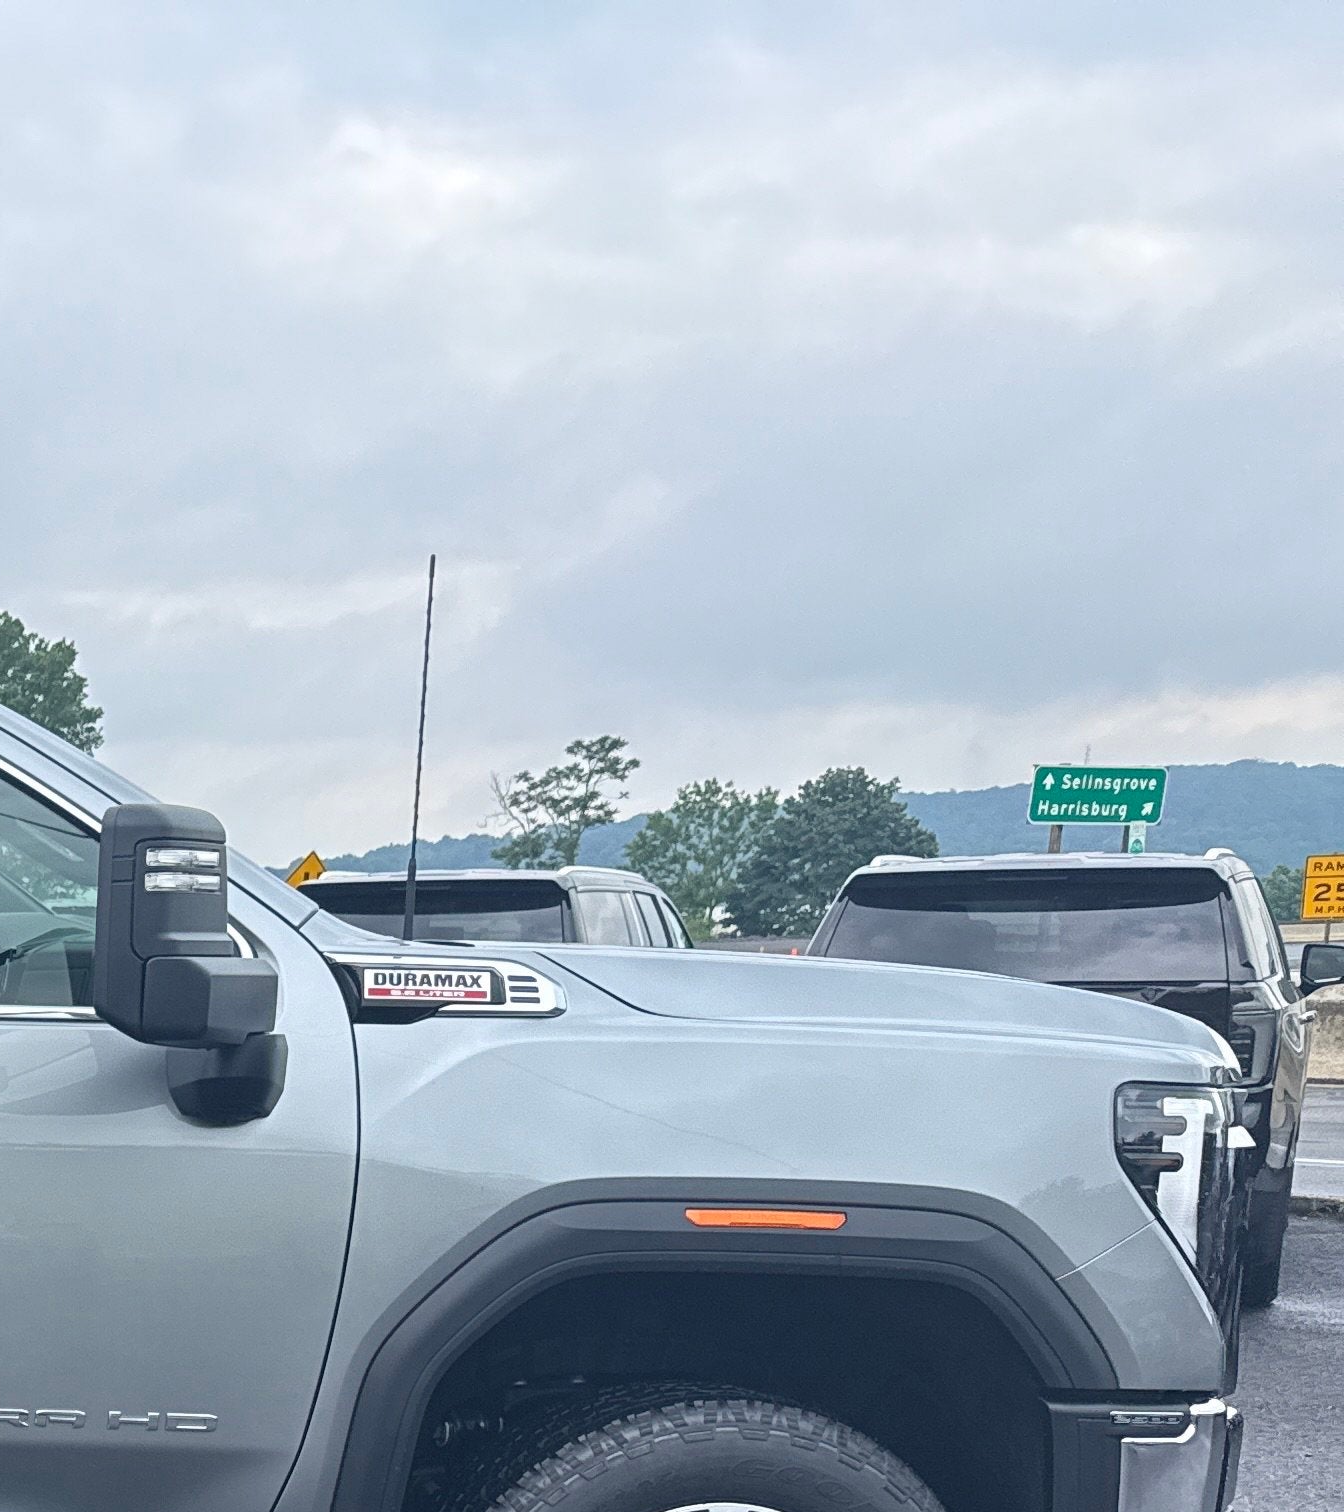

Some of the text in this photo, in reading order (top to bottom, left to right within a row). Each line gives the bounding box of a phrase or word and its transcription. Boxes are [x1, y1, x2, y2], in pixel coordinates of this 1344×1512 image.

[1061, 772, 1158, 795] Selinsgrove
[1036, 799, 1129, 821] Harrisburg
[373, 972, 483, 988] DURAMAX
[107, 1409, 219, 1433] HD
